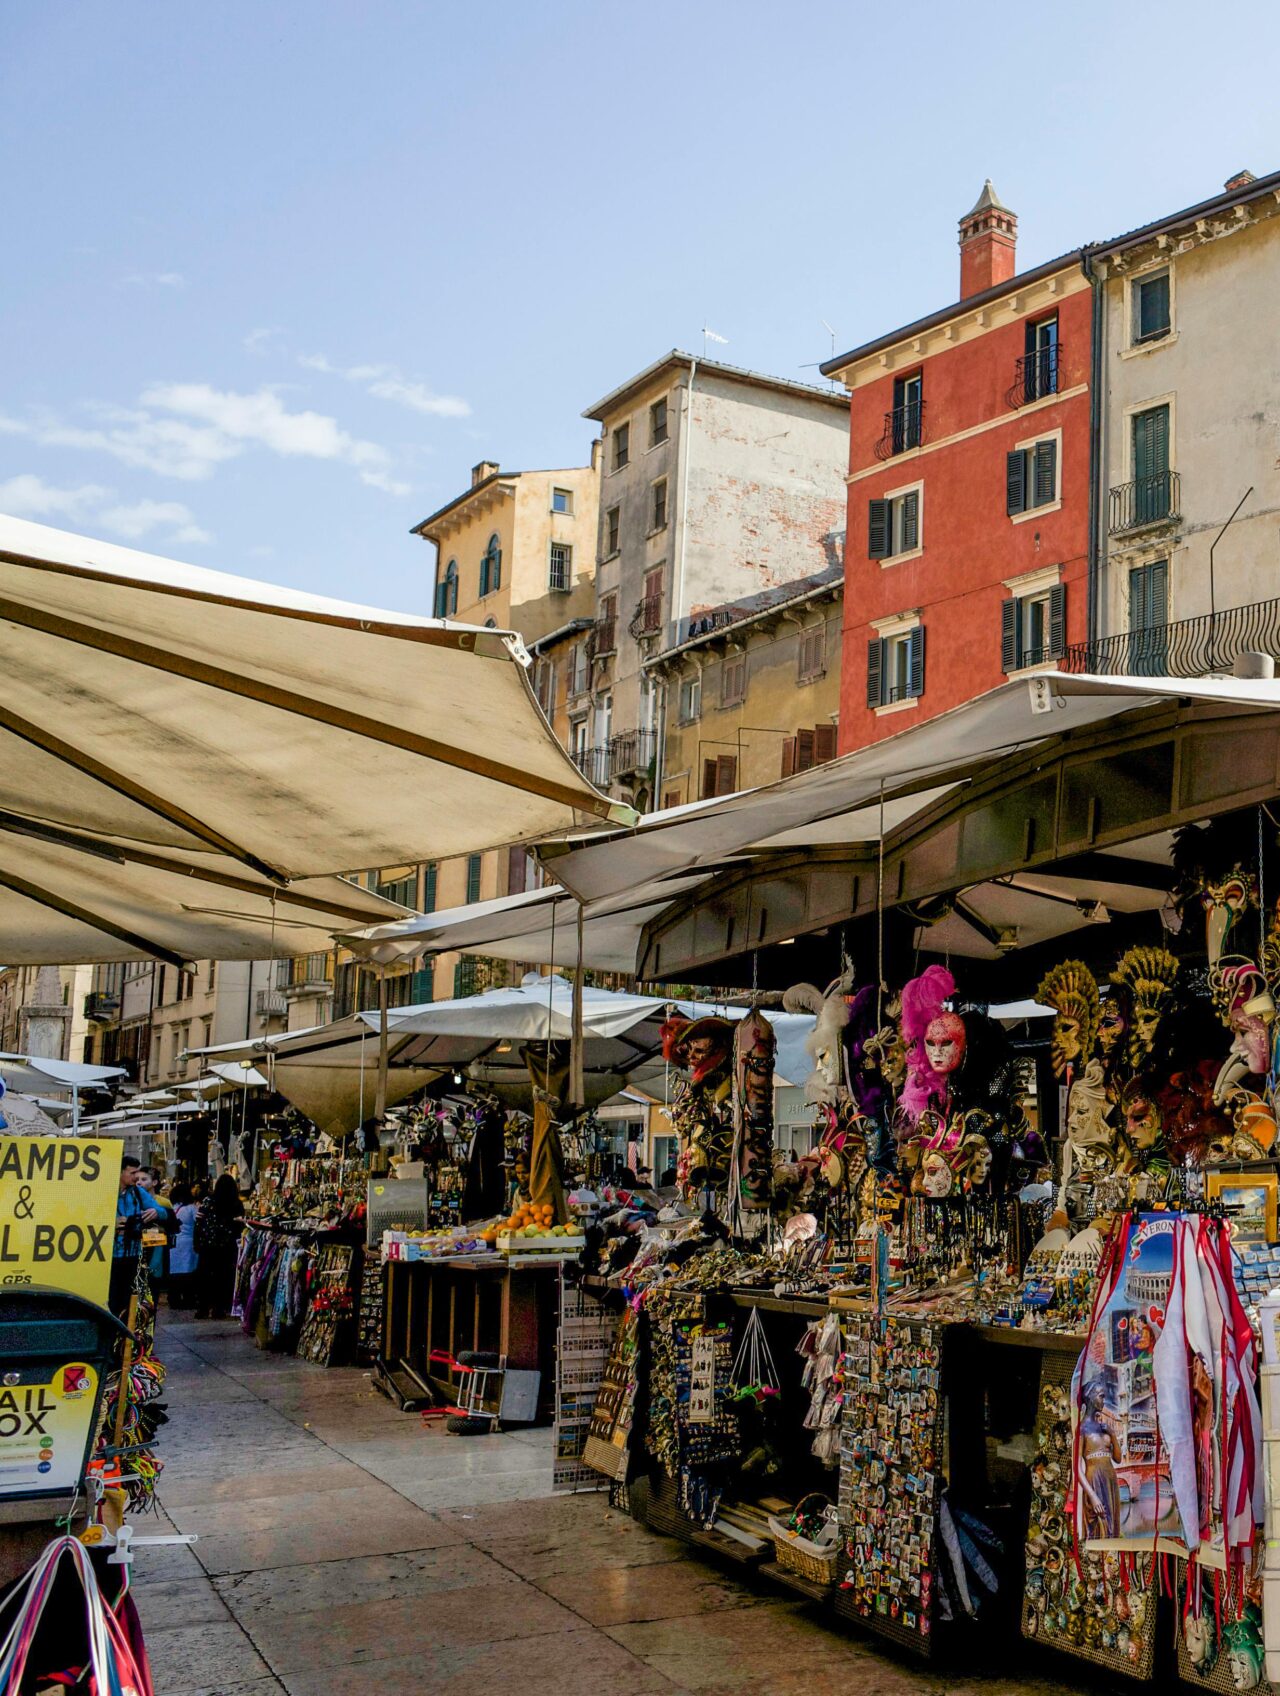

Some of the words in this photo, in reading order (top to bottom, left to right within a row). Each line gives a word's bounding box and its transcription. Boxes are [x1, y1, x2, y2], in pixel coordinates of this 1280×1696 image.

[0, 1142, 102, 1182] AMPS
[13, 1185, 35, 1219] &
[1142, 1219, 1175, 1238] VERON
[32, 1224, 109, 1263] BOX
[2, 1274, 32, 1285] GPS
[0, 1388, 57, 1413] AIL
[0, 1411, 48, 1437] OX
